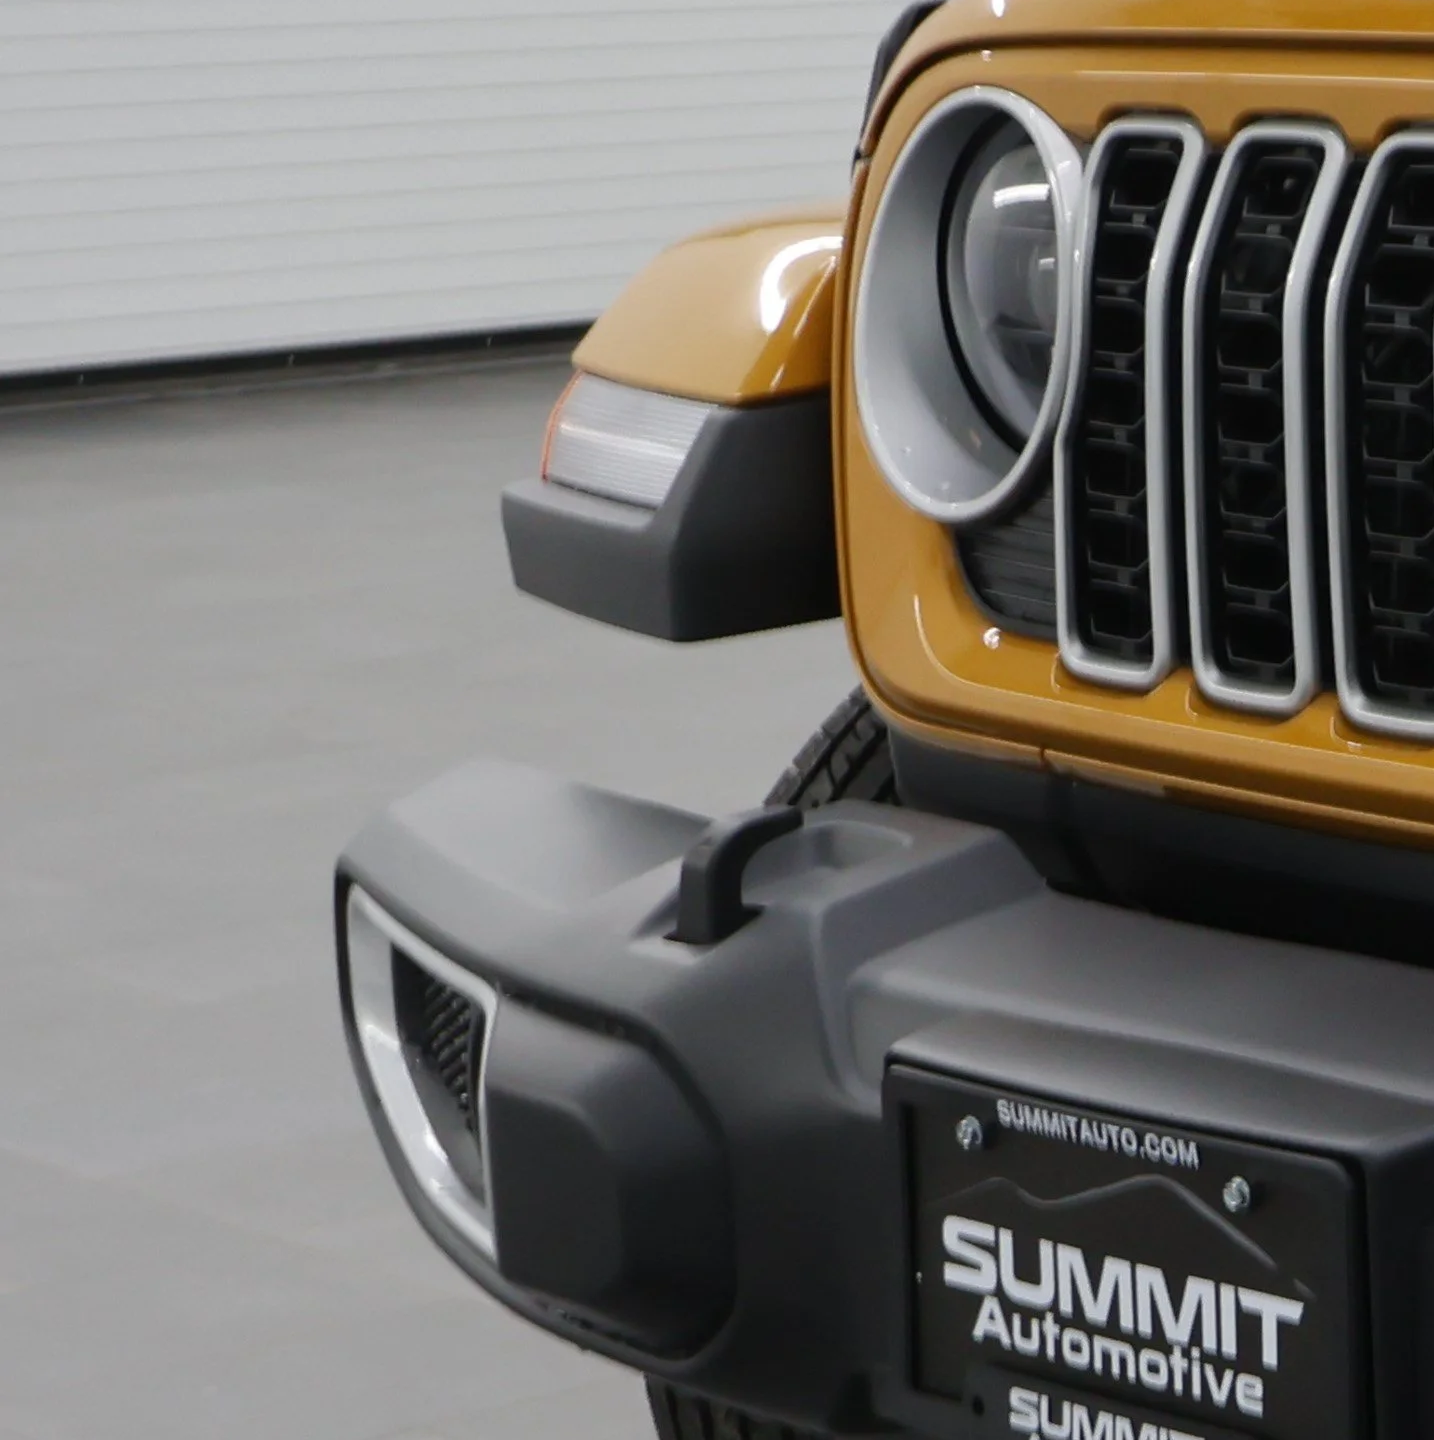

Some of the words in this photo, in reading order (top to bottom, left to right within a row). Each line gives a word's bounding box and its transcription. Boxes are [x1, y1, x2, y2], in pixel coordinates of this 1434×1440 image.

[995, 1098, 1200, 1169] SUMMITAUTO.COM
[941, 1214, 1305, 1371] SUMMIT
[971, 1294, 1265, 1418] Automotive
